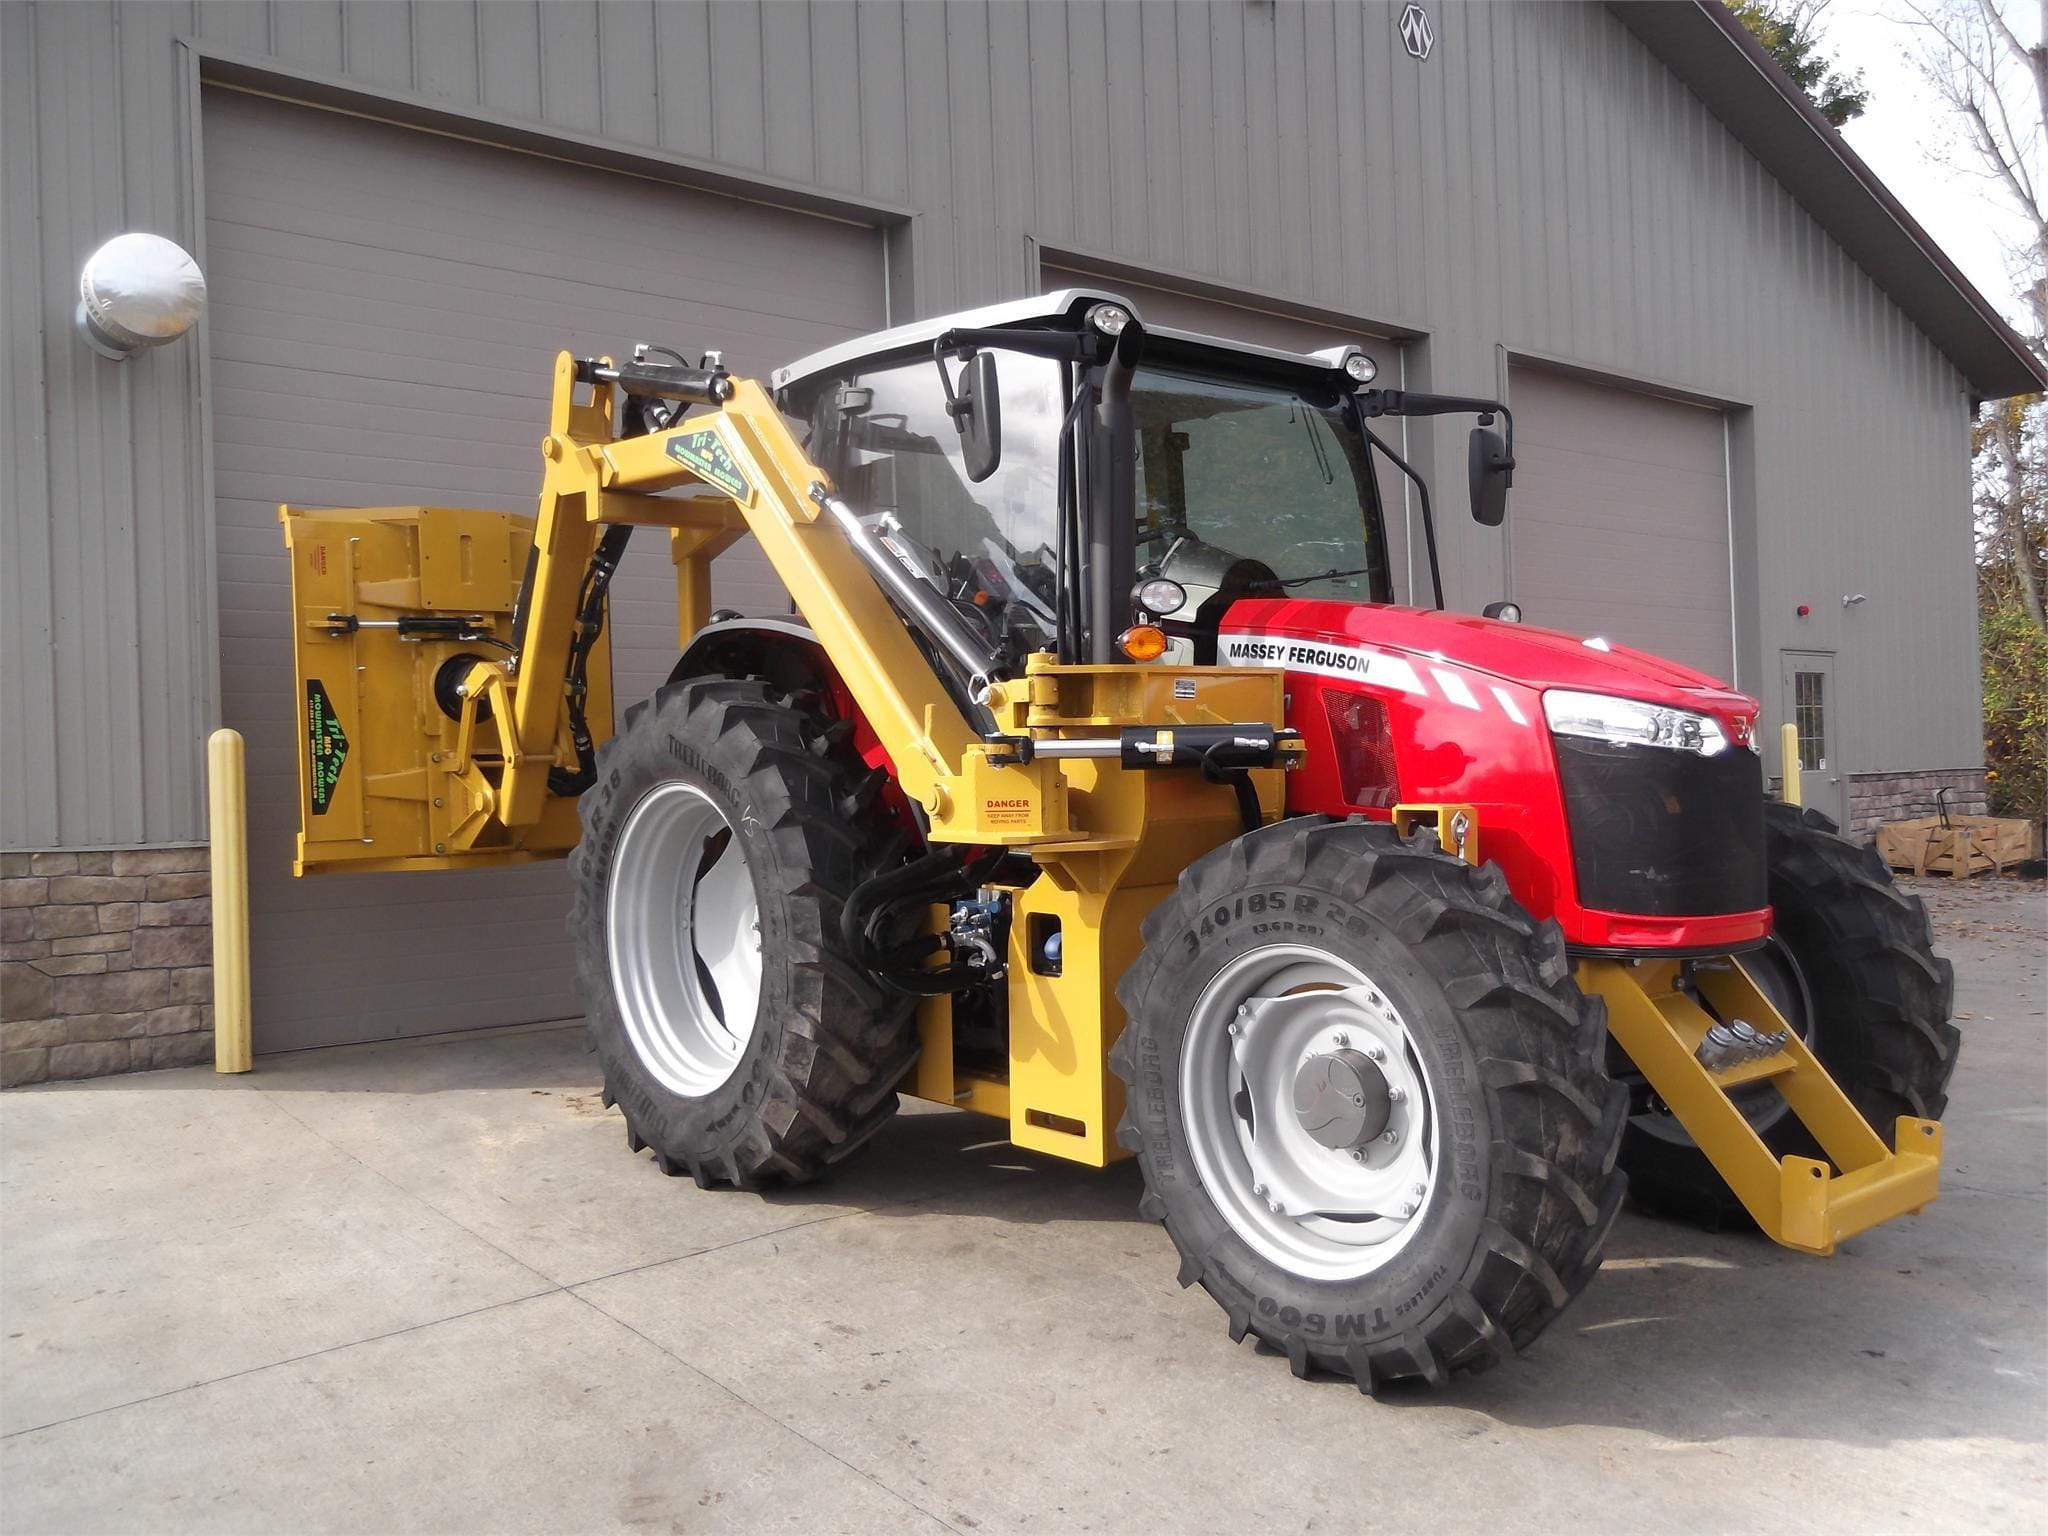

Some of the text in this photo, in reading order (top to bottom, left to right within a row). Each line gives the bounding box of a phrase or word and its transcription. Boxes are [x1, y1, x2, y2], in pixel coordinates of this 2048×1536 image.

[1229, 643, 1370, 674] MASSEY FERGUSON
[317, 761, 326, 804] MOWERS
[987, 799, 1030, 808] DANGER
[1293, 894, 1320, 914] R
